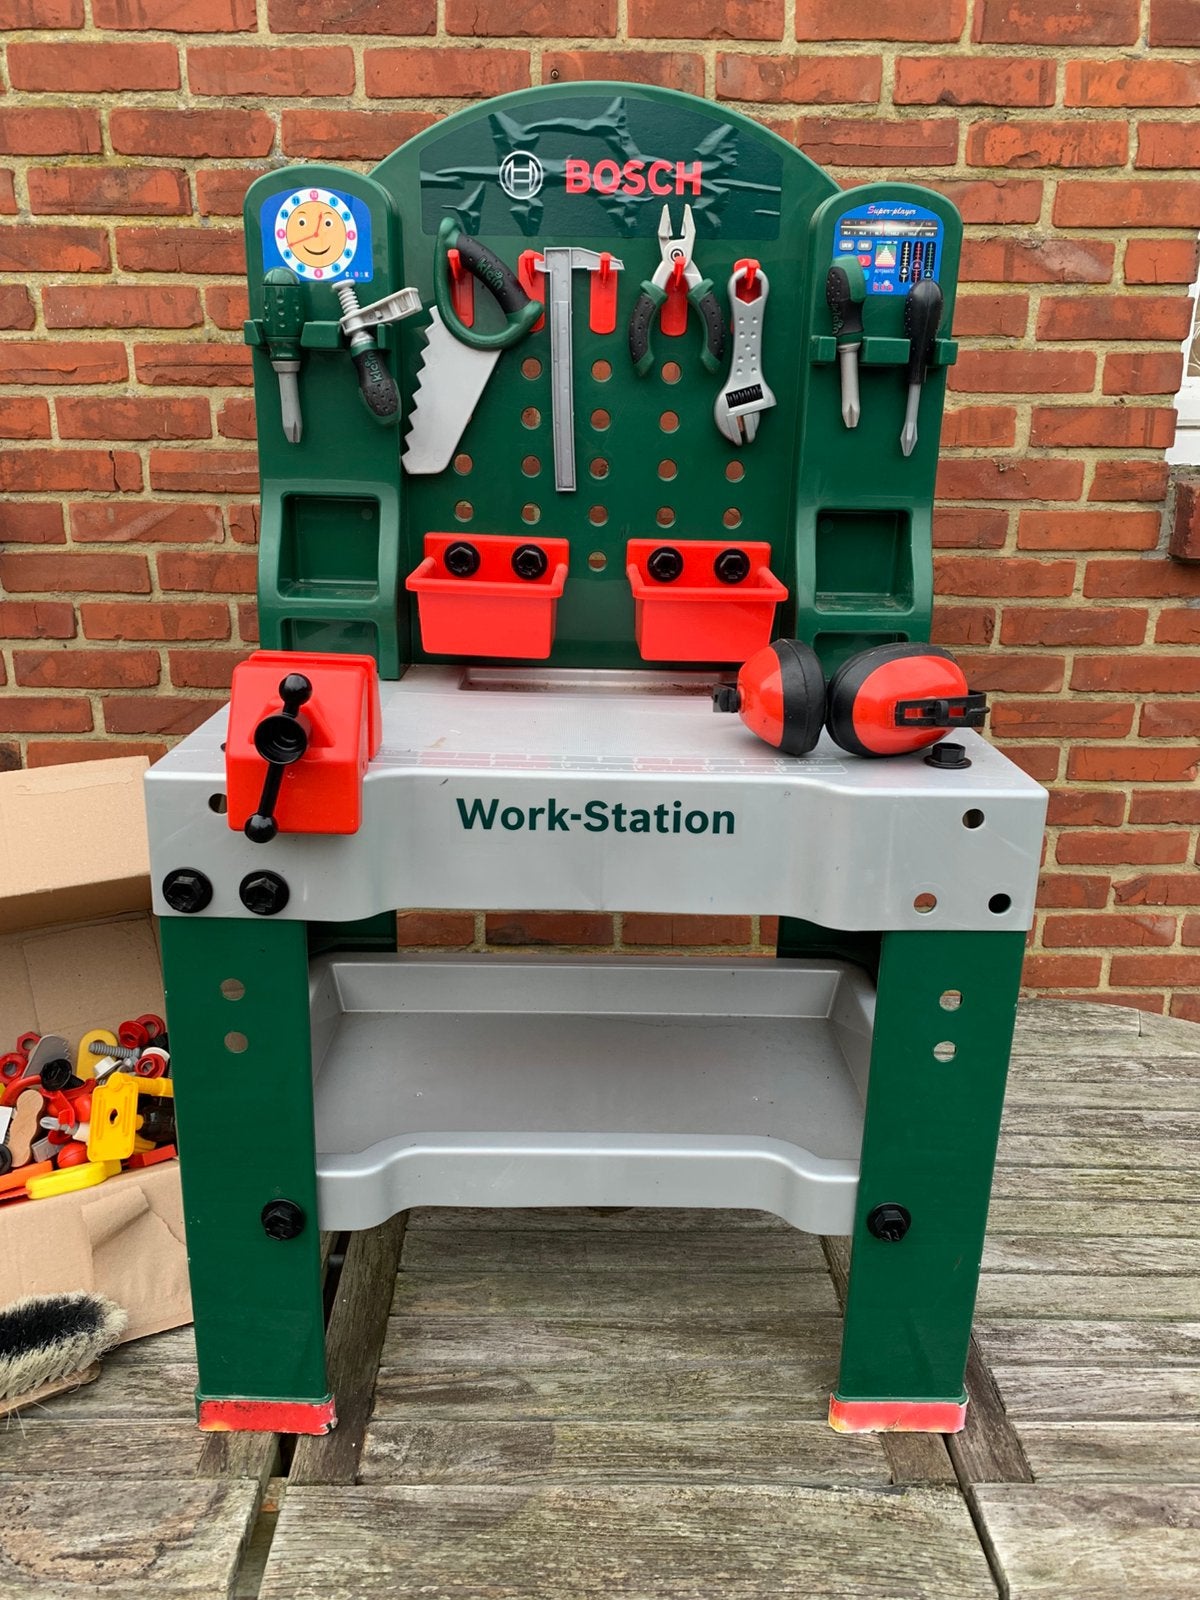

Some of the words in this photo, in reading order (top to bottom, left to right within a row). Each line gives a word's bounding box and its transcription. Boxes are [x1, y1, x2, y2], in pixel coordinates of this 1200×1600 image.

[565, 159, 702, 195] BOSCH
[867, 205, 917, 216] Super-player
[456, 798, 736, 834] Work-Station
